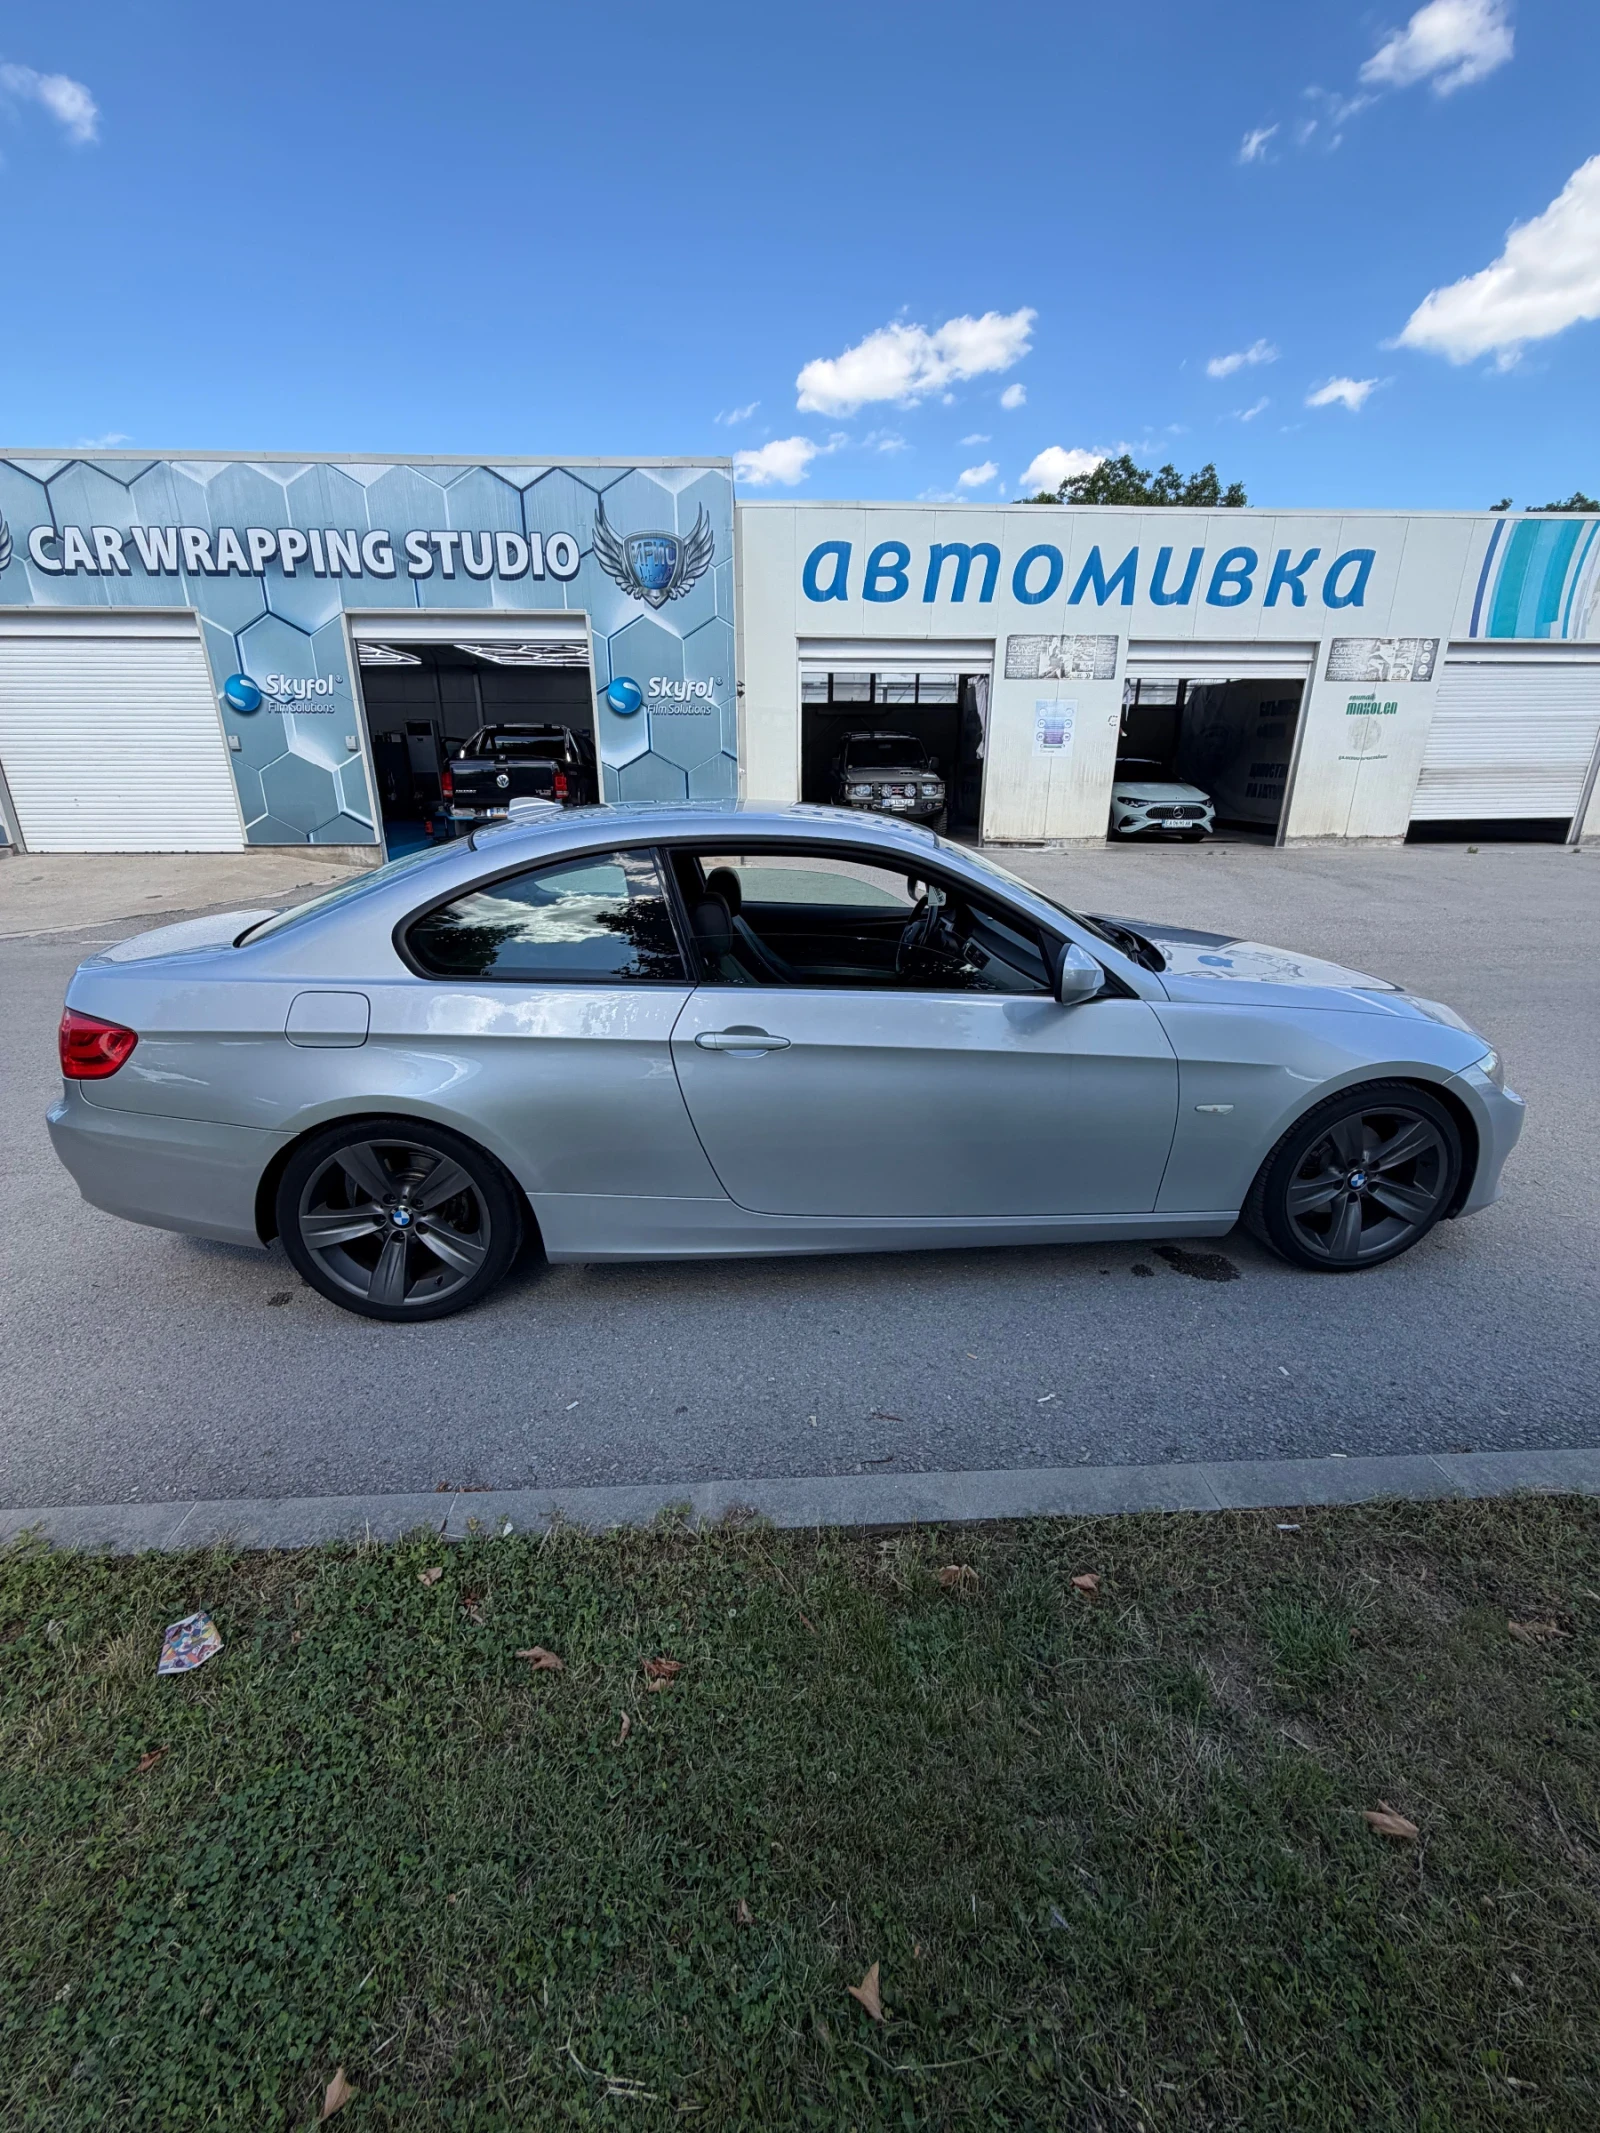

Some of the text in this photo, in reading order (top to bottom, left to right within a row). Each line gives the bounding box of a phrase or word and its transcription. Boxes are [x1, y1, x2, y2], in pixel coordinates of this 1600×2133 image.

[28, 525, 581, 581] CAR WRAPPING STUDIO
[801, 540, 1376, 609] автомивка
[268, 702, 335, 714] Film Solutions
[647, 703, 711, 716] Film Solutions
